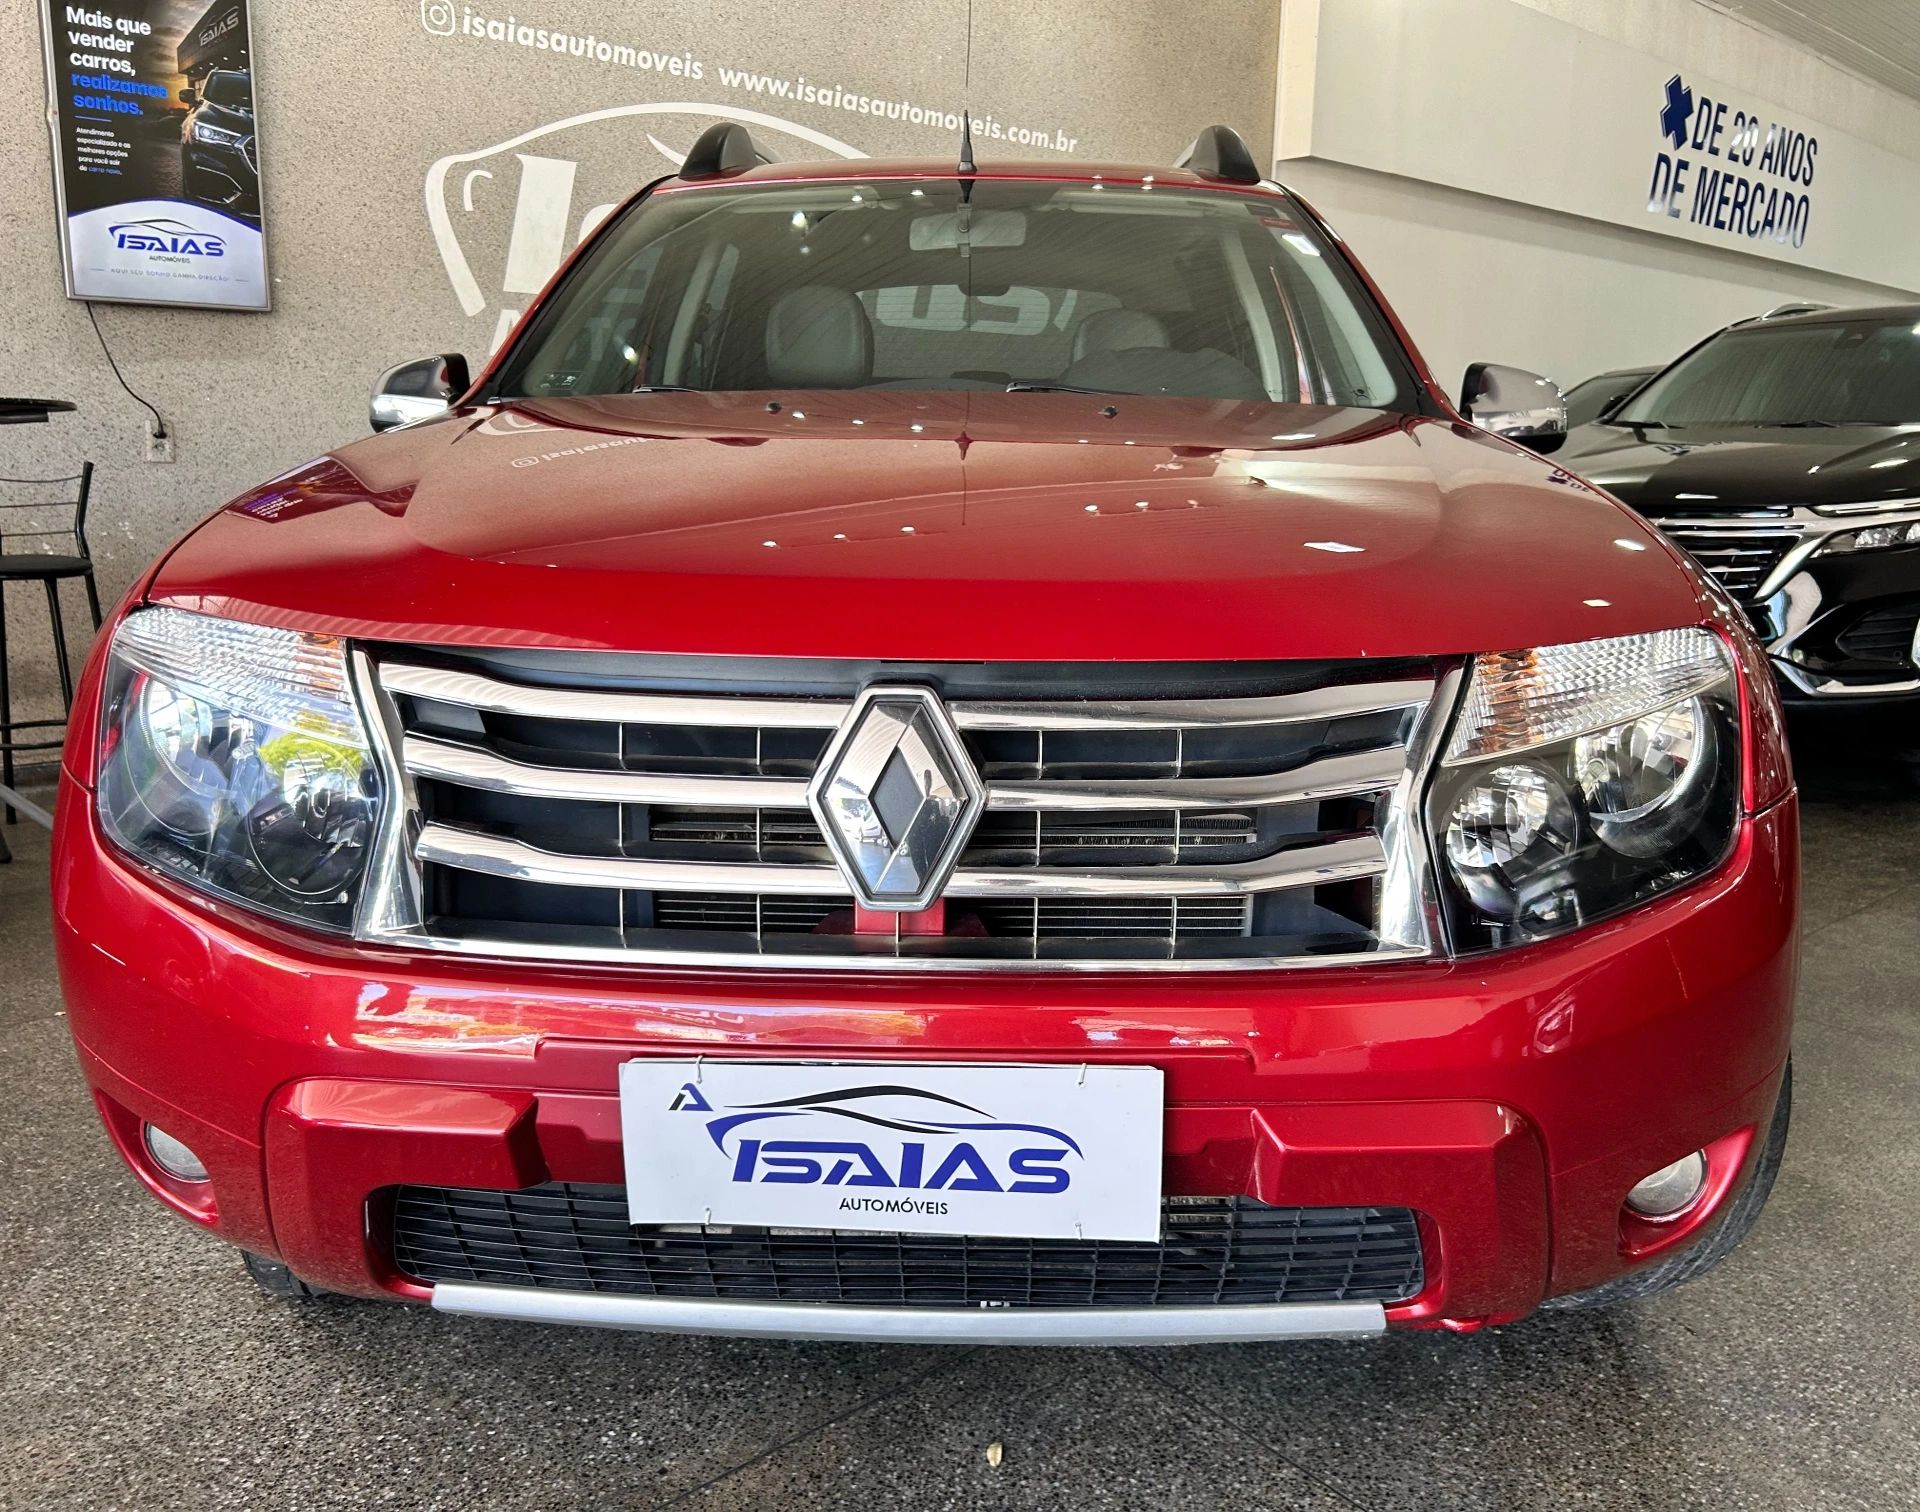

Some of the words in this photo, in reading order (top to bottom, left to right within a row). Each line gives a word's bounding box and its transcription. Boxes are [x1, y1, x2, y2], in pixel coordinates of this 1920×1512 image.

[66, 6, 112, 29] Mais
[115, 18, 151, 36] que
[68, 31, 134, 53] vender
[462, 7, 703, 79] isaiasautomoveis
[70, 52, 136, 76] carros,
[71, 73, 169, 99] realizamos
[74, 94, 144, 116] sonhos.
[718, 67, 1077, 153] www.isaiasautomoveis.com.br
[1691, 96, 1728, 157] DE
[1728, 110, 1759, 167] 20
[1759, 122, 1818, 187] ANOS
[1647, 152, 1690, 219] DE
[1690, 165, 1810, 249] MERCADO
[117, 233, 224, 257] ISAIAS
[149, 254, 191, 264] AUTOMÓVEIS
[732, 1139, 1071, 1194] ISAIAS
[839, 1196, 949, 1216] AUTOMÓVEIS
